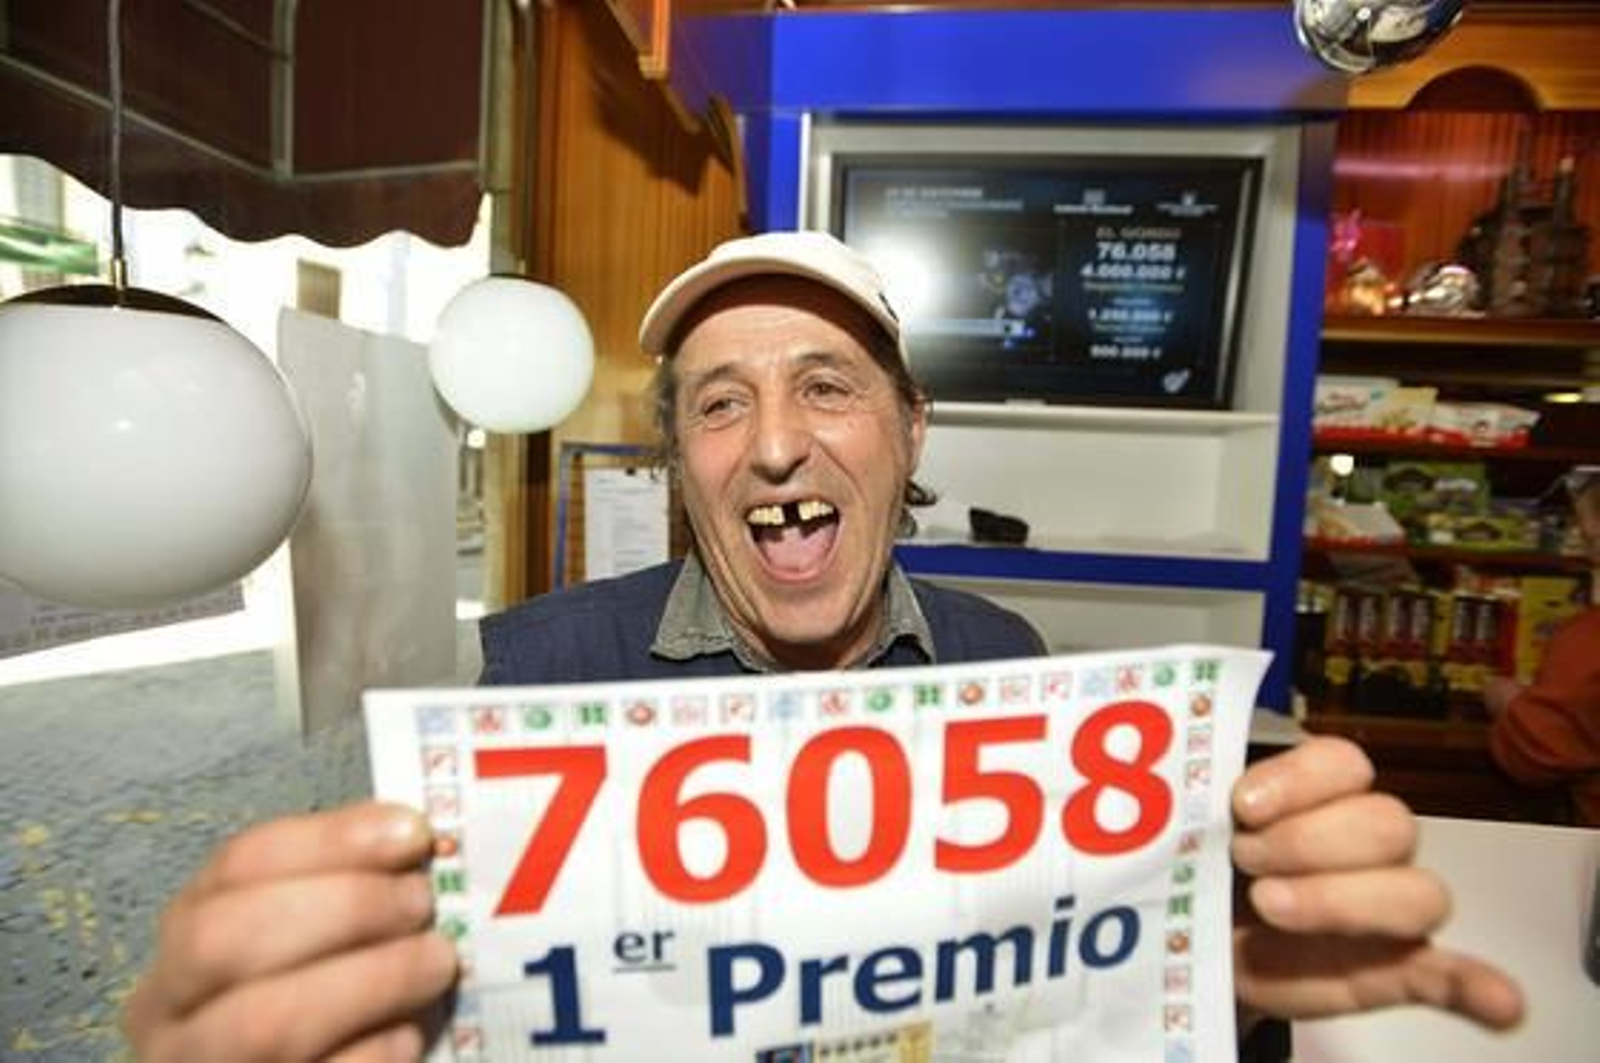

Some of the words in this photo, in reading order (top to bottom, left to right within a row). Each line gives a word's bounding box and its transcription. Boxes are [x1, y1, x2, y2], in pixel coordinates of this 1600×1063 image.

[474, 700, 1174, 917] 76058
[523, 945, 606, 1048] 1
[612, 930, 674, 962] er
[707, 895, 1141, 1038] Premio
